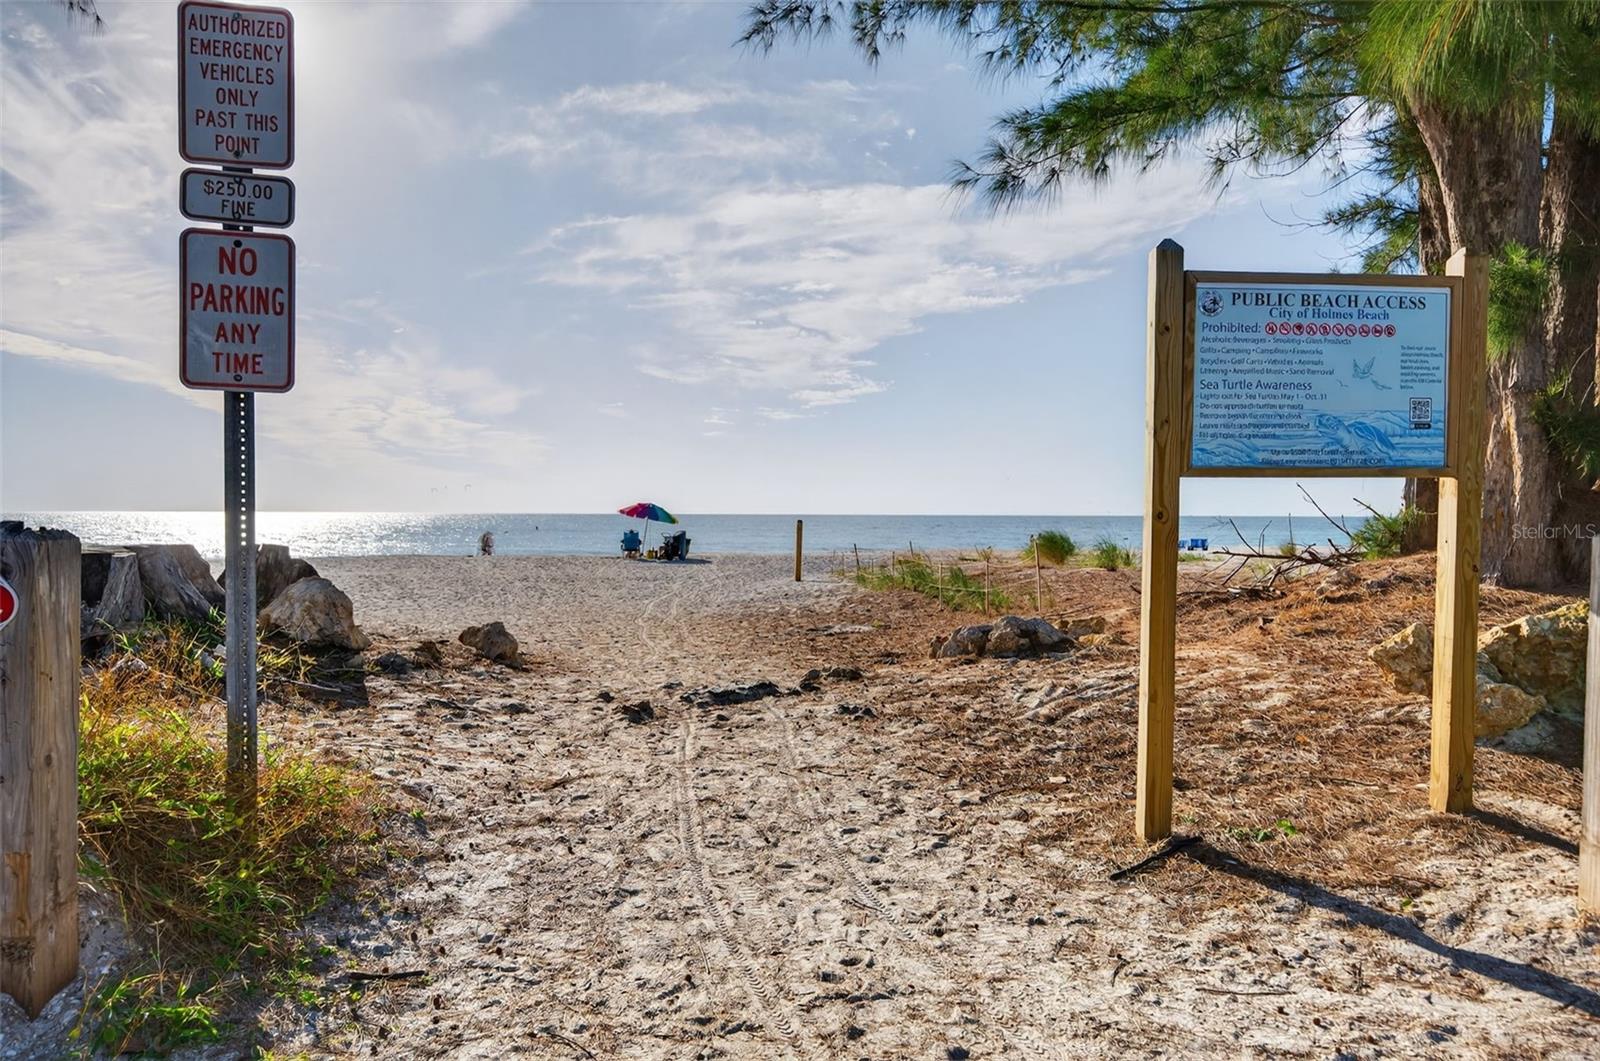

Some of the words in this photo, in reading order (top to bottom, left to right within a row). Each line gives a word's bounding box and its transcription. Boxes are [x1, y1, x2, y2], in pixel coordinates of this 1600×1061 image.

[188, 13, 285, 39] AUTHORIZED
[190, 37, 283, 62] EMERGENCY
[200, 62, 274, 85] VEHICLES
[216, 87, 259, 107] ONLY
[195, 109, 237, 129] PAST
[245, 114, 279, 132] THIS
[215, 134, 260, 154] POINT
[203, 179, 273, 200] $250.00
[221, 199, 256, 216] FINE
[219, 246, 258, 276] NO
[190, 282, 285, 316] PARKING
[1232, 292, 1296, 307] PUBLIC
[1301, 293, 1359, 308] BEACH
[1363, 295, 1426, 310] ACCESS
[1269, 307, 1293, 321] City
[1297, 308, 1310, 319] of
[1312, 308, 1354, 320] Holmes
[1357, 309, 1390, 320] Beach
[215, 322, 261, 344] ANY
[1202, 322, 1261, 334] Prohibited:
[212, 352, 264, 375] TIME
[1200, 379, 1219, 390] Sea
[1222, 379, 1253, 390] Turtle
[1256, 380, 1312, 391] Awareness
